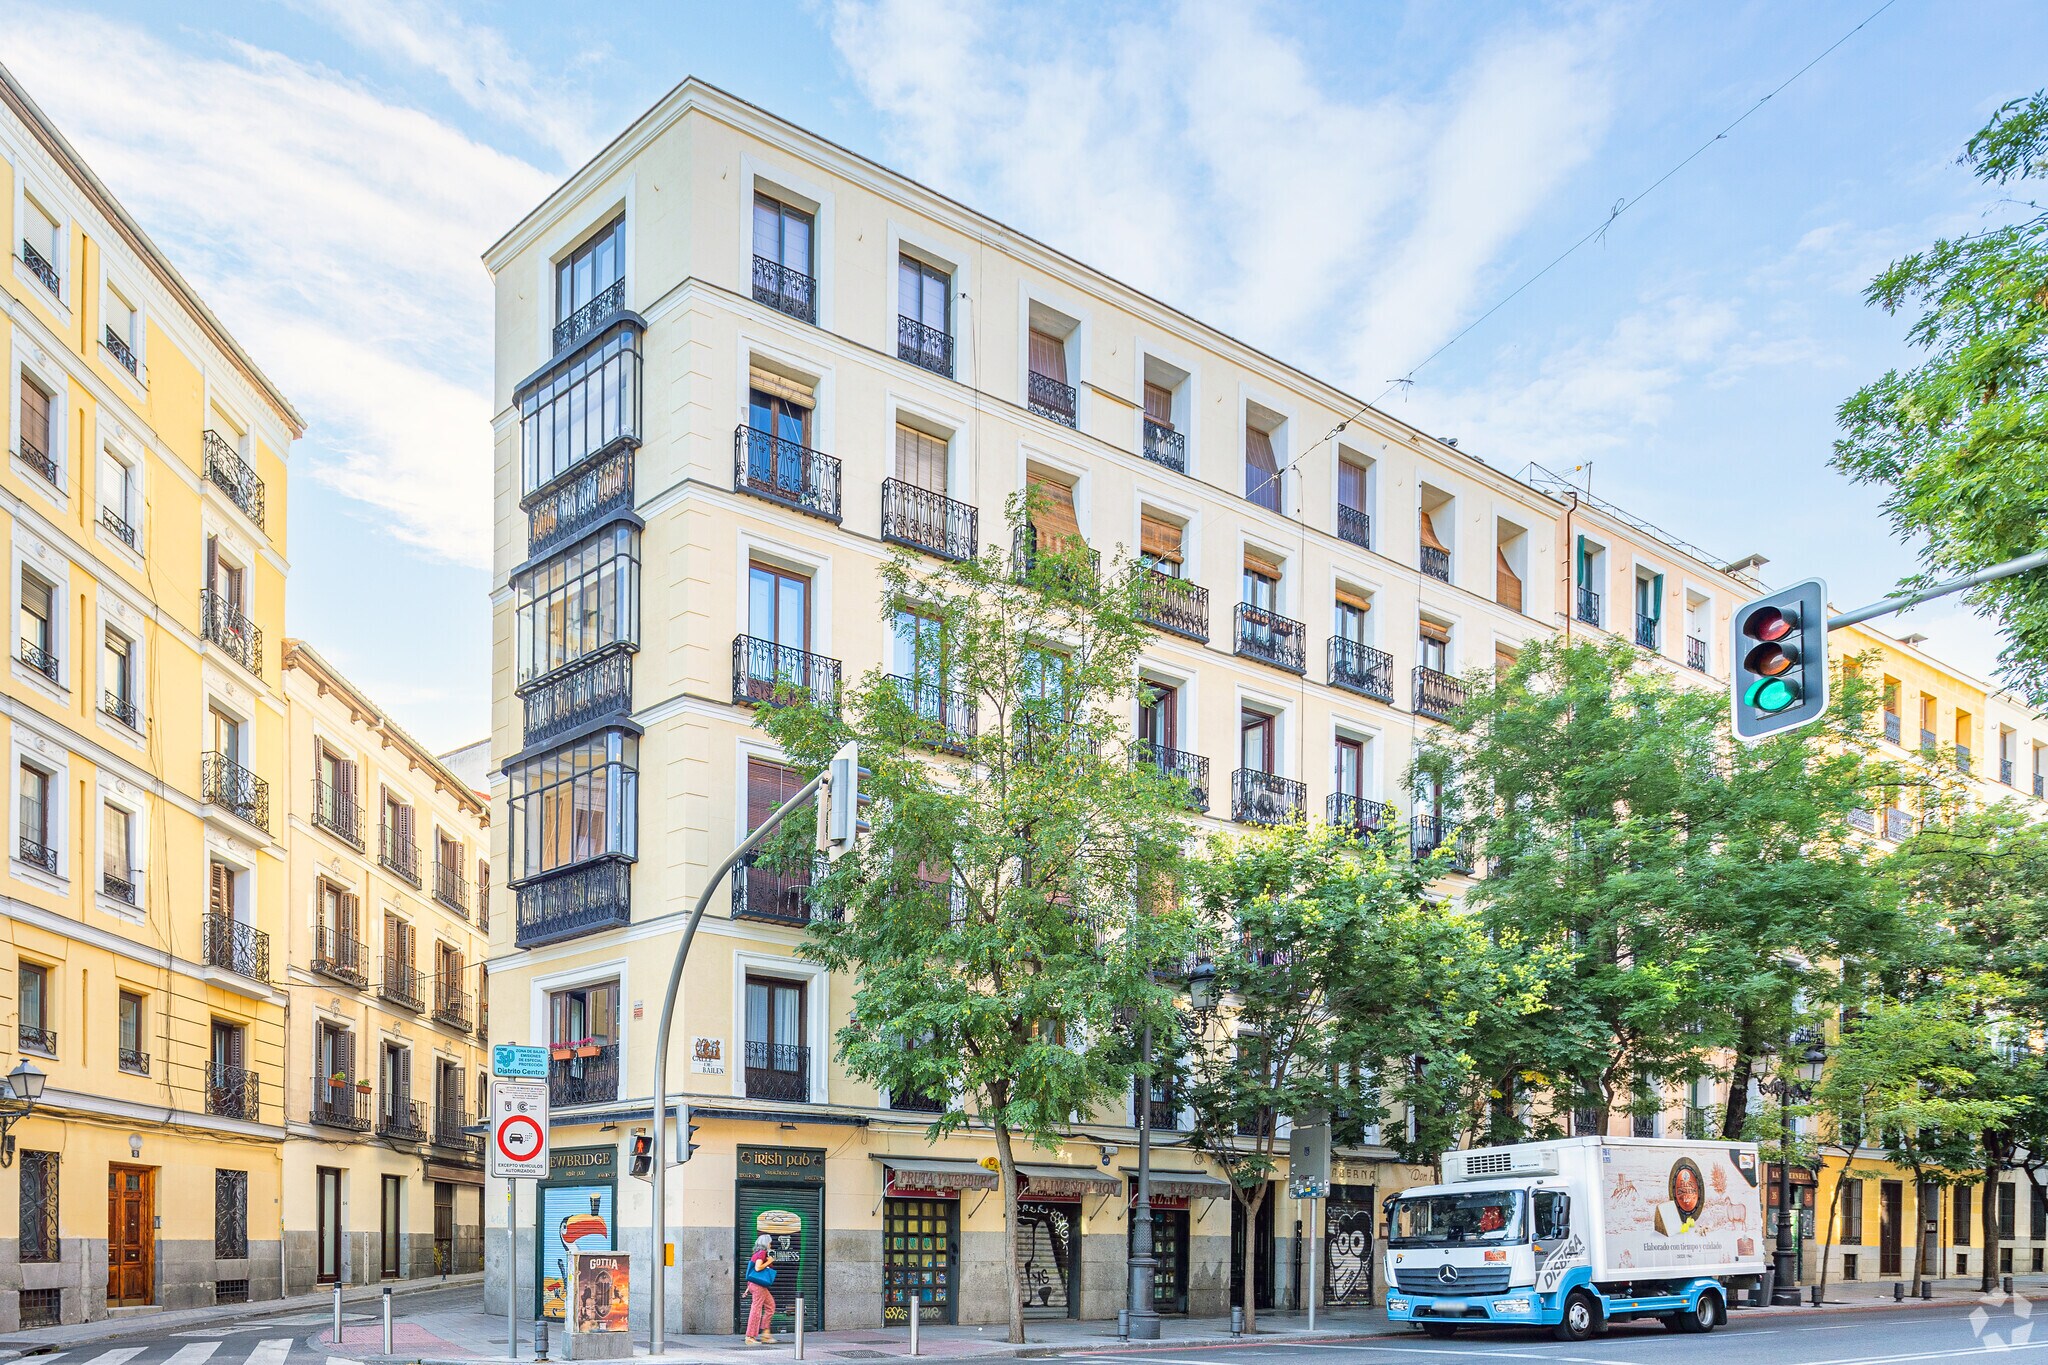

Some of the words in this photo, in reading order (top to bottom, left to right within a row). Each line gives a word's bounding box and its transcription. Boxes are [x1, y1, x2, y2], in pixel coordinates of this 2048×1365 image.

[550, 1152, 610, 1168] EWBRIDGE
[900, 1171, 934, 1185] FRUTA
[937, 1172, 943, 1186] Y
[1331, 1167, 1376, 1180] ABERNA
[1034, 1180, 1118, 1194] ALIMENTACION
[1170, 1183, 1209, 1196] BAZAR
[1643, 1242, 1669, 1251] Elaborado
[1680, 1242, 1699, 1252] tiempo
[1702, 1241, 1722, 1250] cuidado
